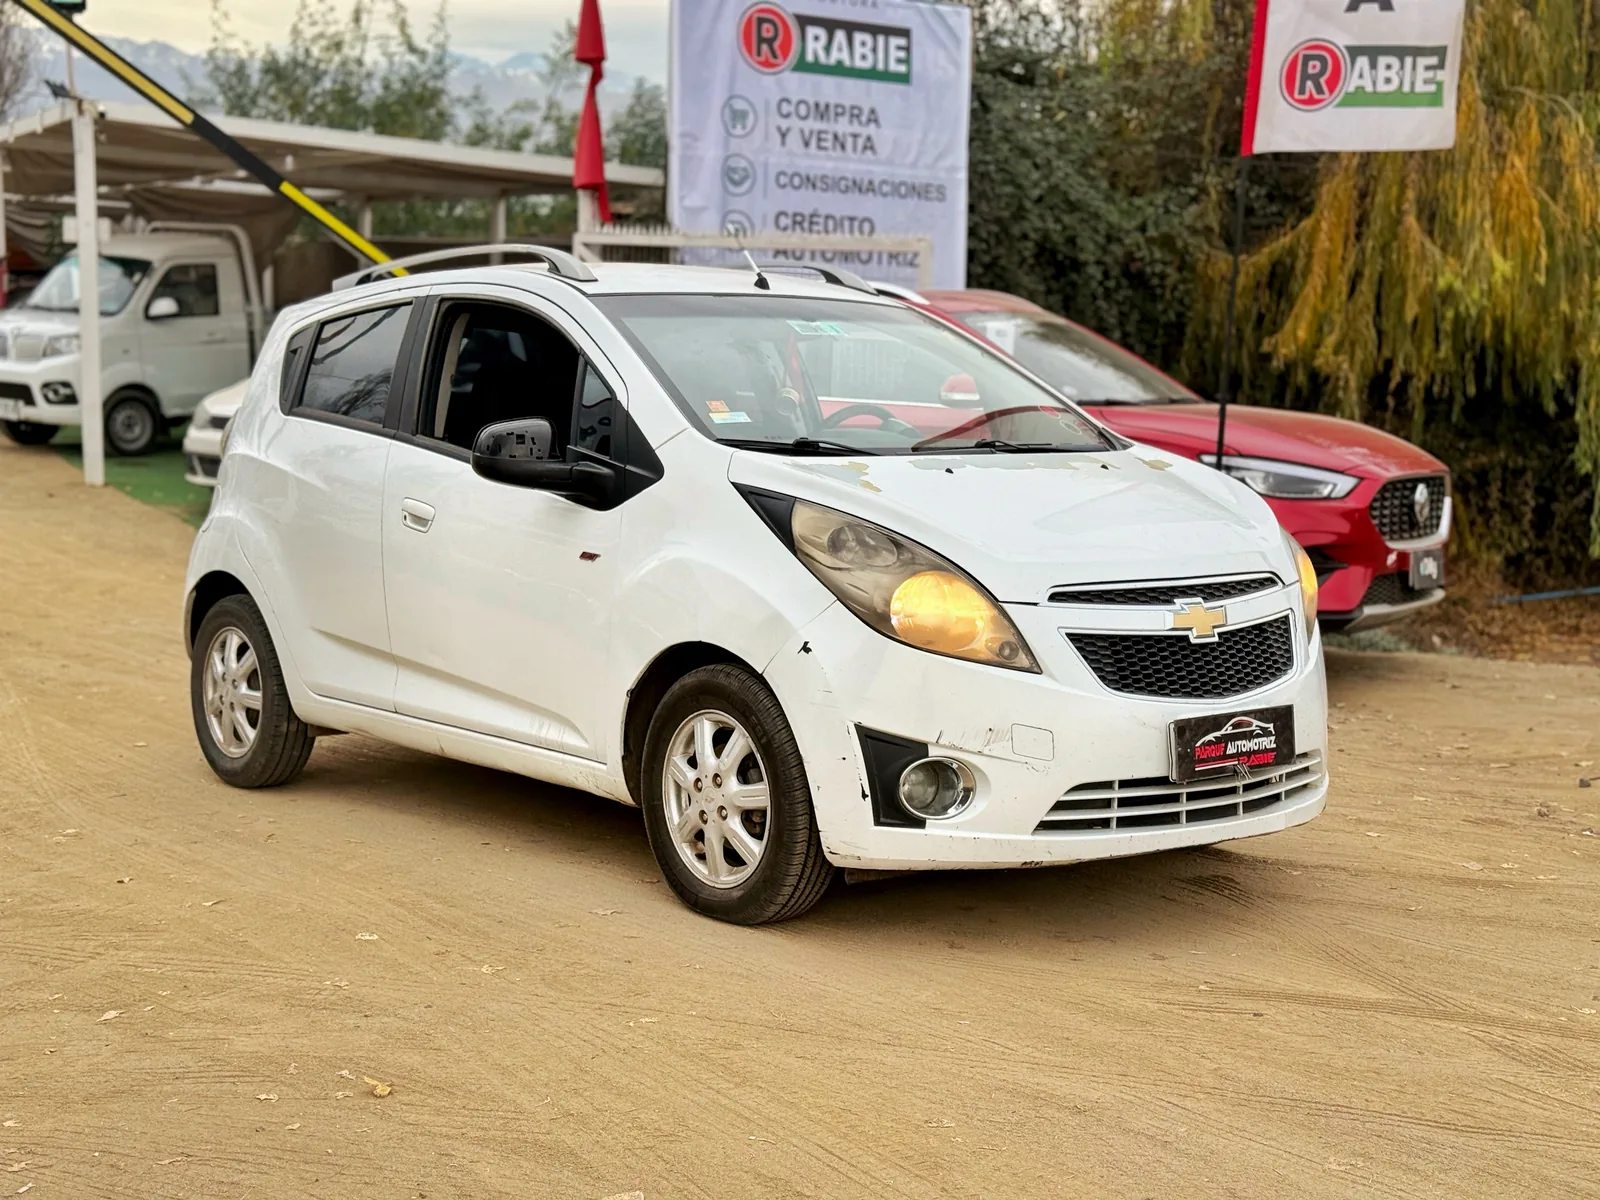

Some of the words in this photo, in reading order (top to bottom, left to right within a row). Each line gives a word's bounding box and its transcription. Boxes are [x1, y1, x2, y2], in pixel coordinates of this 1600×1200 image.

[804, 24, 909, 74] RABIE
[776, 97, 881, 129] COMPRA
[776, 125, 792, 149] Y
[800, 128, 878, 156] VENTA
[774, 169, 947, 203] CONSIGNACIONES
[773, 207, 876, 238] CRÉDITO
[1226, 736, 1277, 755] AUTOMOTRIZ
